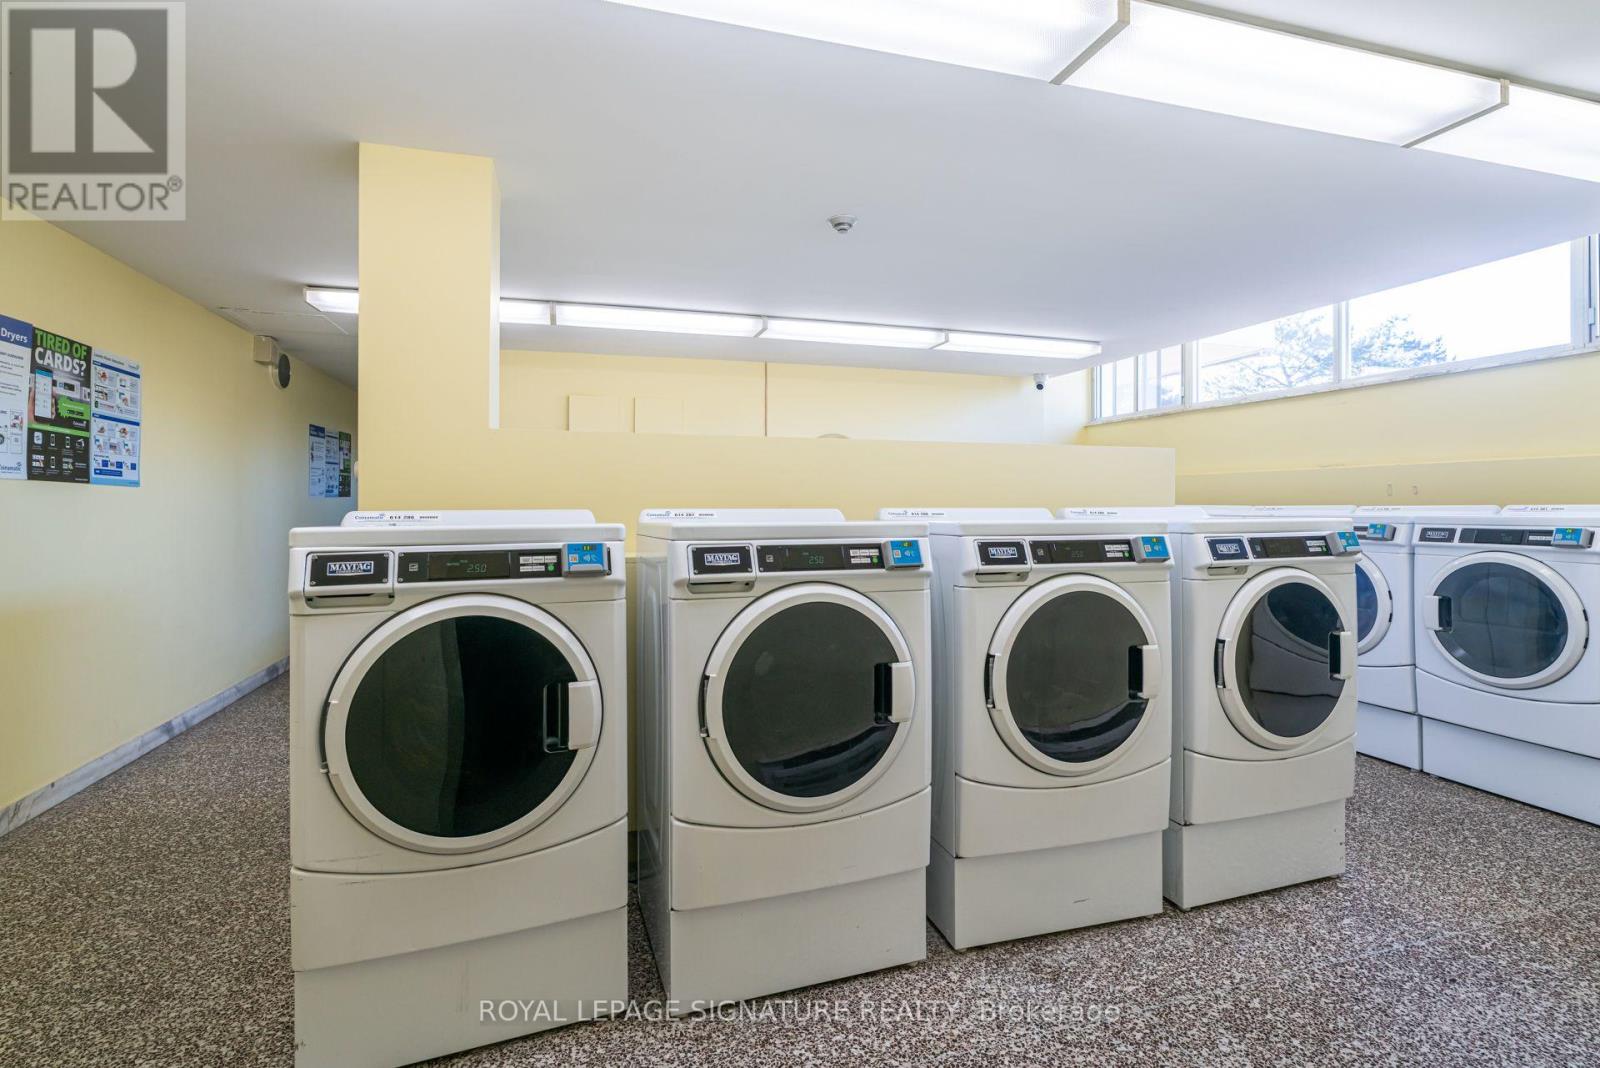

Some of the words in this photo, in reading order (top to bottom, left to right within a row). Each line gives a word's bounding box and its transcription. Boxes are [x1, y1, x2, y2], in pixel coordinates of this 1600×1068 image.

[1, 327, 28, 343] Dryers
[35, 329, 70, 355] TIRED
[72, 342, 88, 359] OF
[34, 347, 87, 376] CARDS?
[706, 553, 738, 562] MAYTAG
[329, 562, 371, 572] MAYTAG
